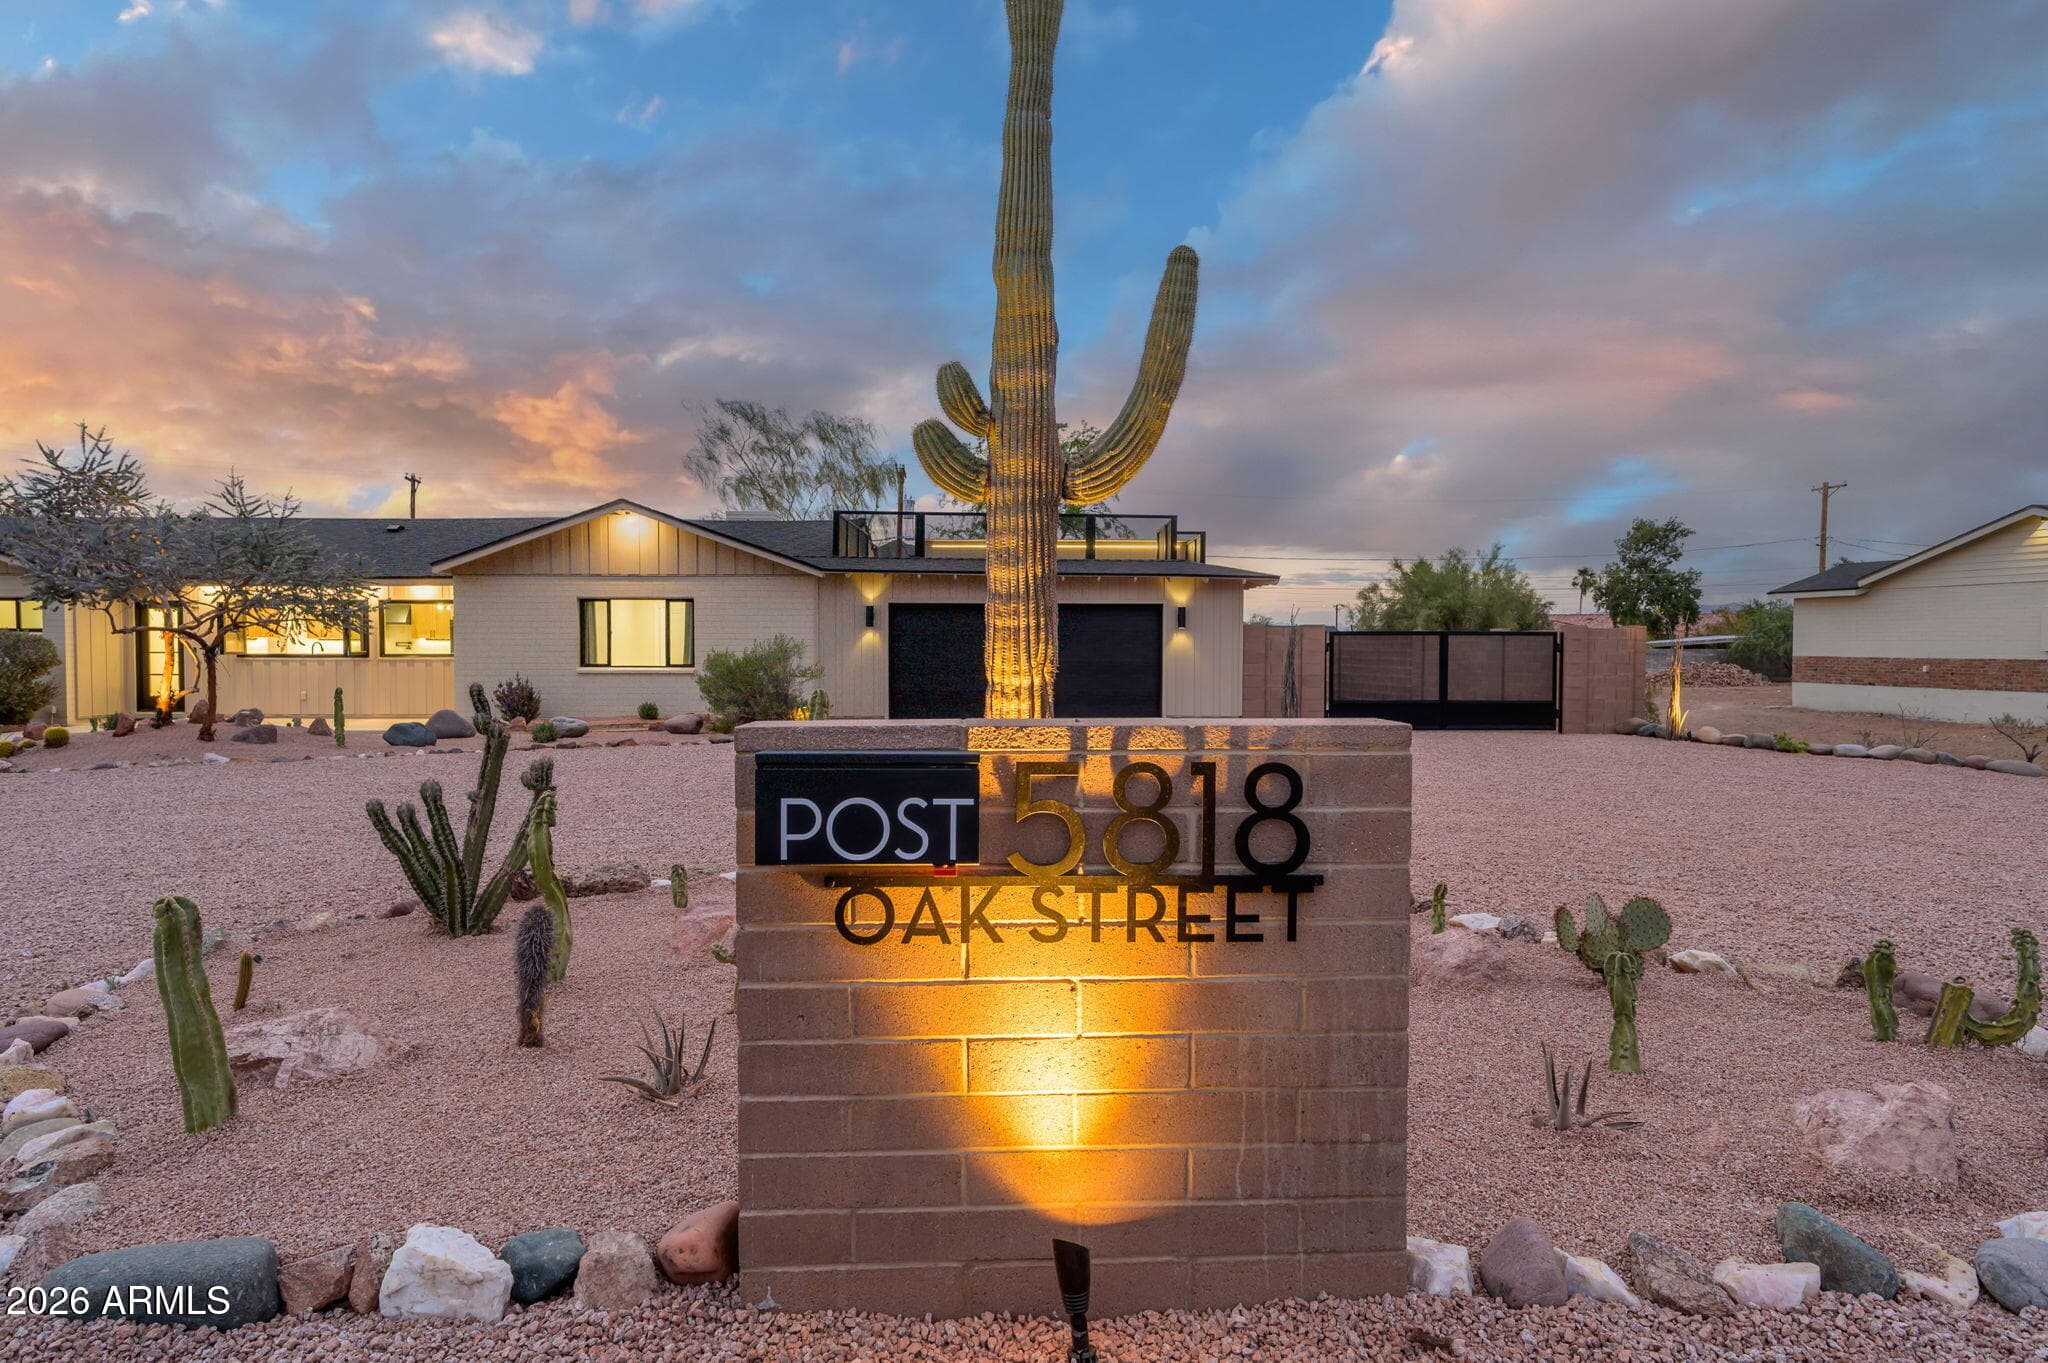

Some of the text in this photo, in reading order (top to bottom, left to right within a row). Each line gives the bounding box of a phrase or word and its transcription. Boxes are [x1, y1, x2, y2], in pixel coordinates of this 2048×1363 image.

[780, 797, 975, 861] POST
[1006, 761, 1311, 877] 5818
[834, 882, 1315, 945] OAK STREET
